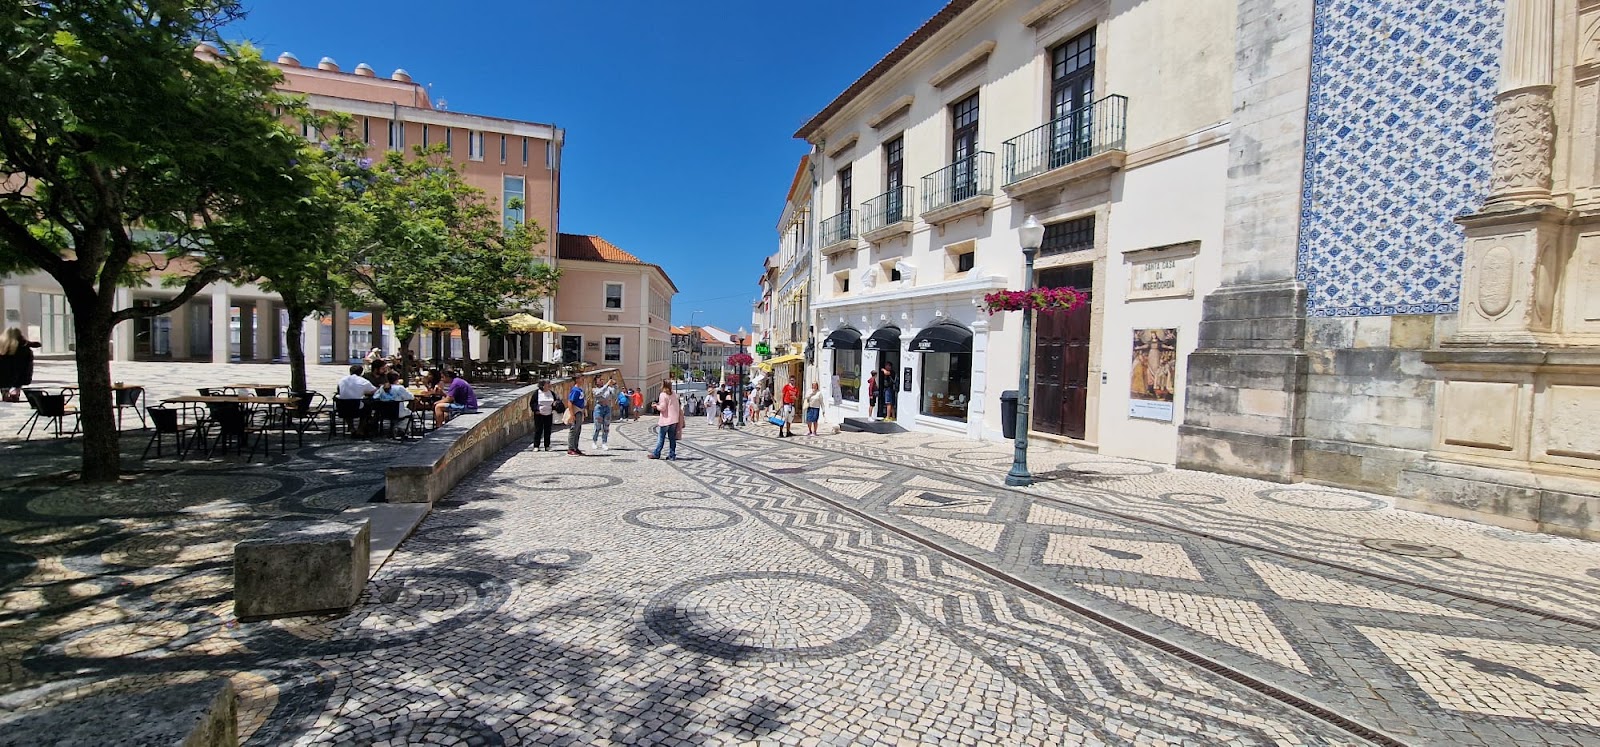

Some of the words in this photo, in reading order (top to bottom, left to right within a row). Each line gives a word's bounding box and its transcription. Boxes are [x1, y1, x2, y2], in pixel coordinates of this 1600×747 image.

[1145, 262, 1160, 272] SANTA
[1162, 260, 1176, 269] CASA
[1156, 271, 1163, 280] DA
[1143, 280, 1175, 291] MISERICORDIA
